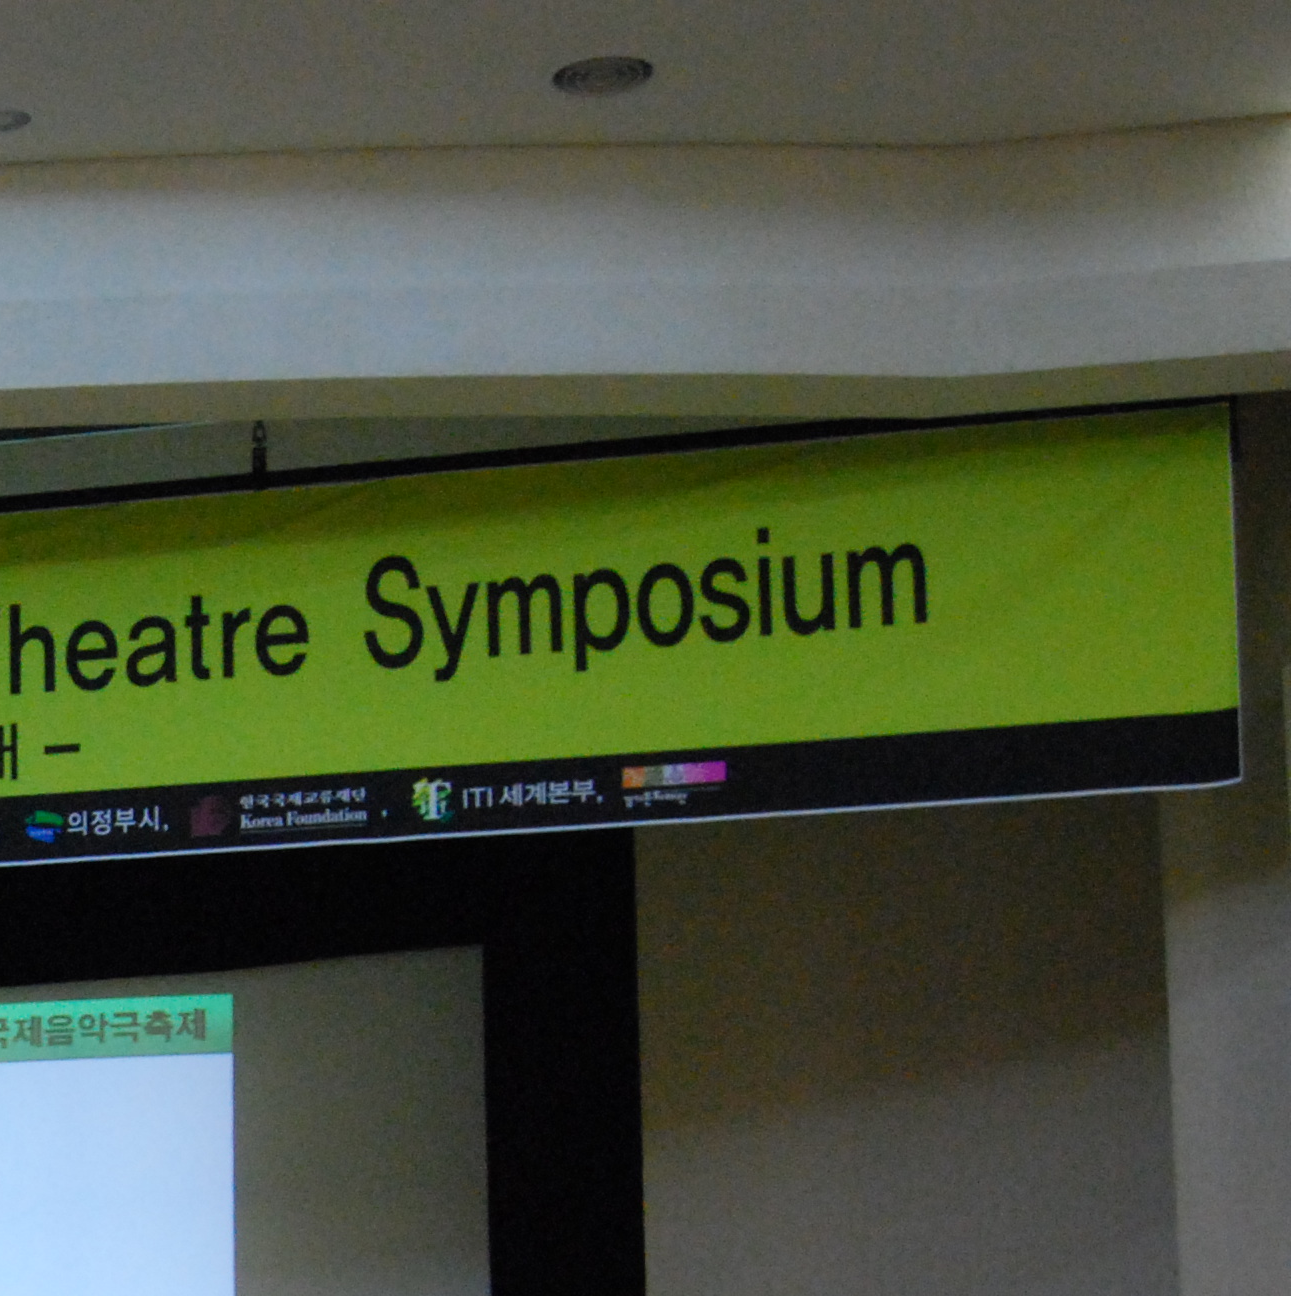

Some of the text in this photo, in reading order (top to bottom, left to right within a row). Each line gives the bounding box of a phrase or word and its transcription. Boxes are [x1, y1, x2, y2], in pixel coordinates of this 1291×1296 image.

[364, 527, 929, 683] Symposium
[462, 786, 493, 809] ITI
[499, 779, 603, 806] 세계본부,
[67, 804, 170, 840] 의정부시,
[240, 807, 368, 828] Korea Foundation
